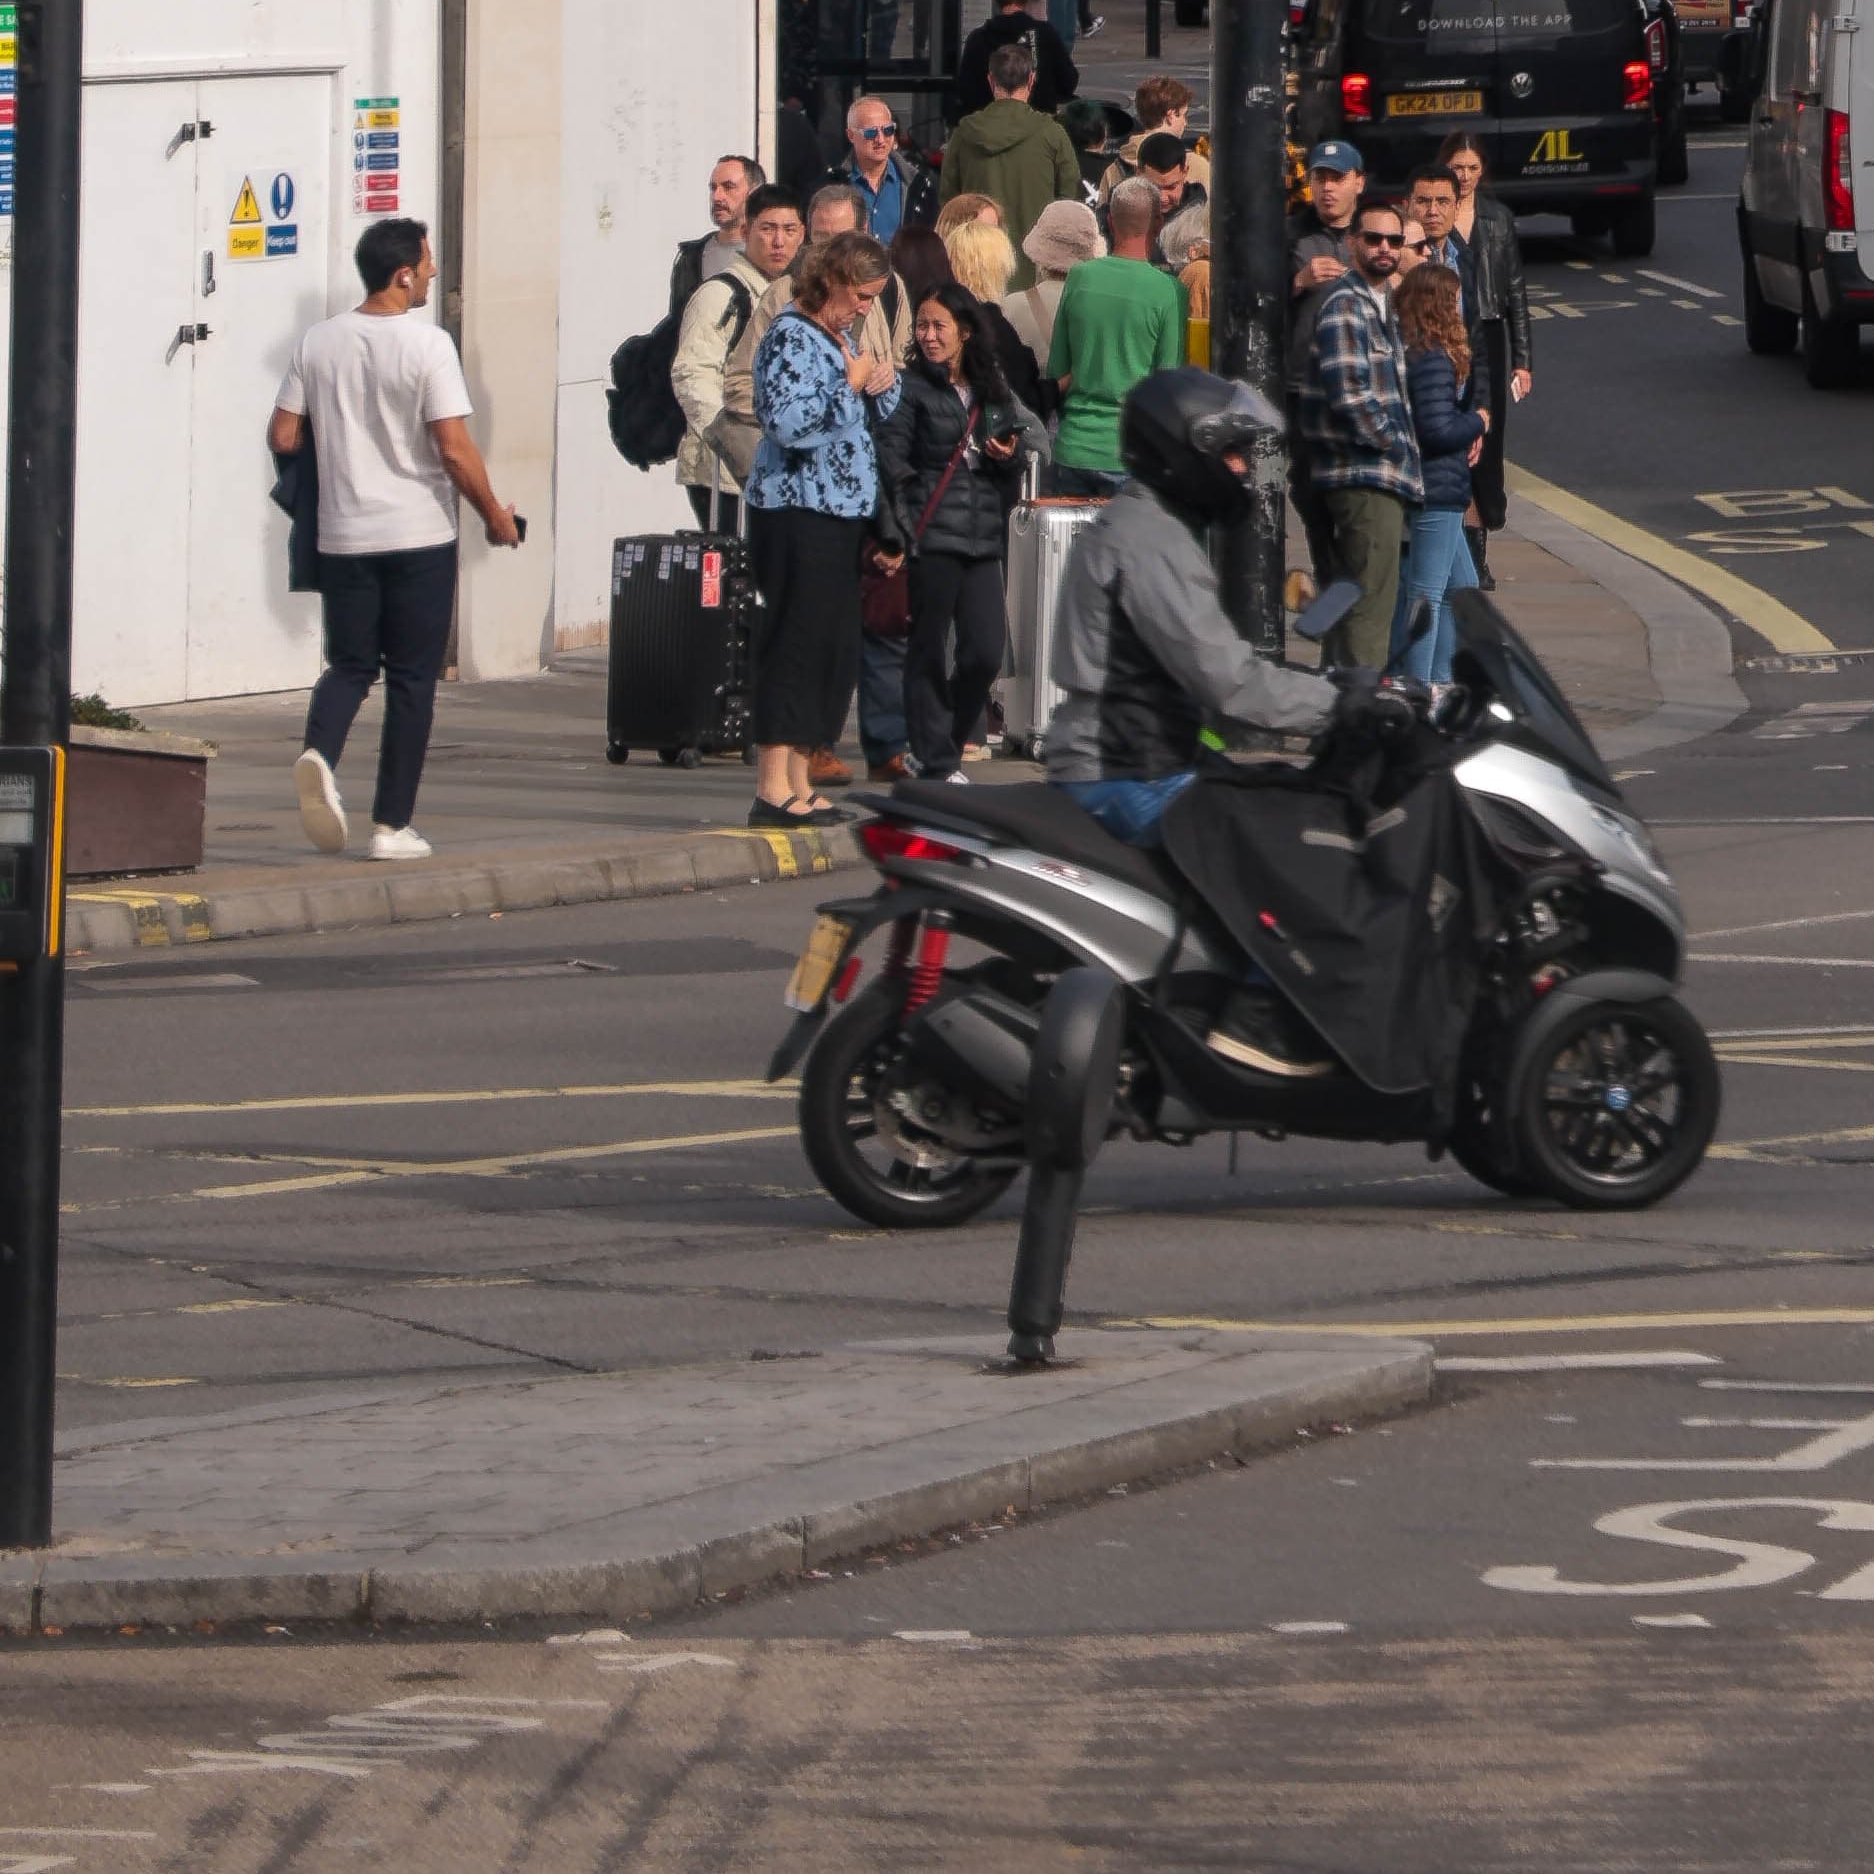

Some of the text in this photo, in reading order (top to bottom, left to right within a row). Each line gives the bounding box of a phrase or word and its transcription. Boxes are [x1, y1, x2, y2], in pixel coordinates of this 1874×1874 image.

[1418, 14, 1573, 31] DOWNLOAD THE APP
[1530, 129, 1584, 162] AL
[232, 237, 260, 251] Danger
